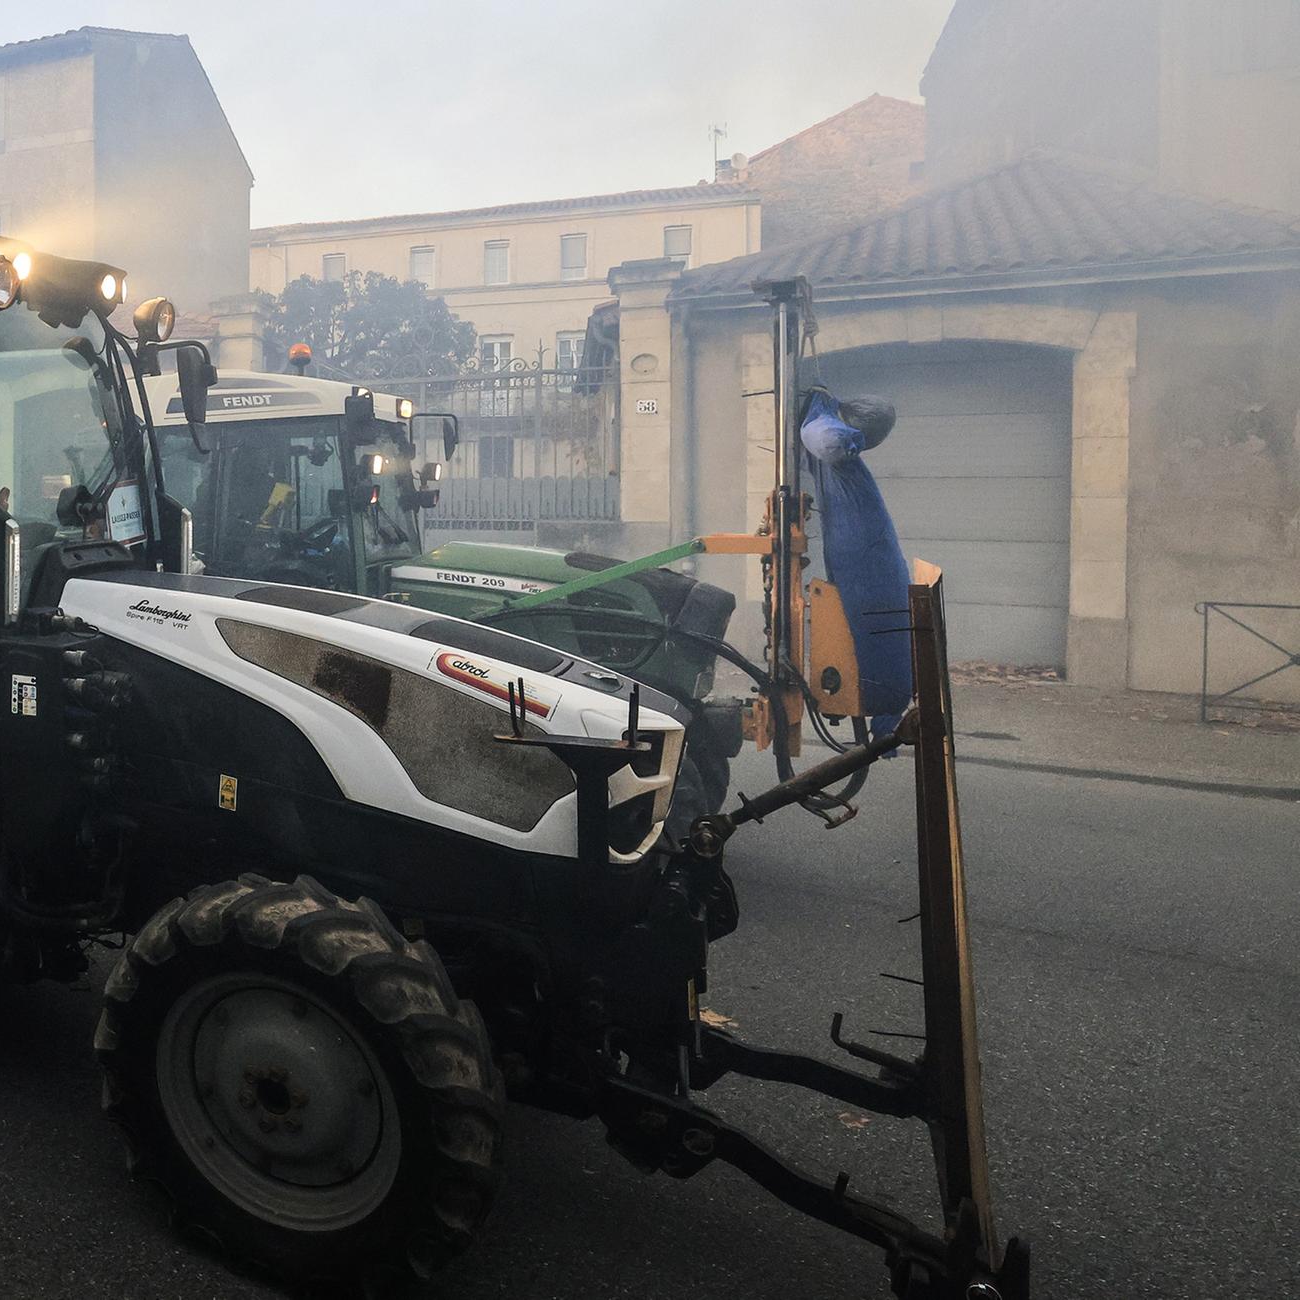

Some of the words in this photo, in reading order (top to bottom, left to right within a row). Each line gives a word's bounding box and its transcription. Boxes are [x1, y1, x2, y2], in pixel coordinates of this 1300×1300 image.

[223, 394, 272, 407] FENDT
[436, 572, 476, 584] FENDT
[482, 577, 505, 587] 209
[129, 600, 191, 621] Lamborghini
[452, 660, 490, 678] abrol
